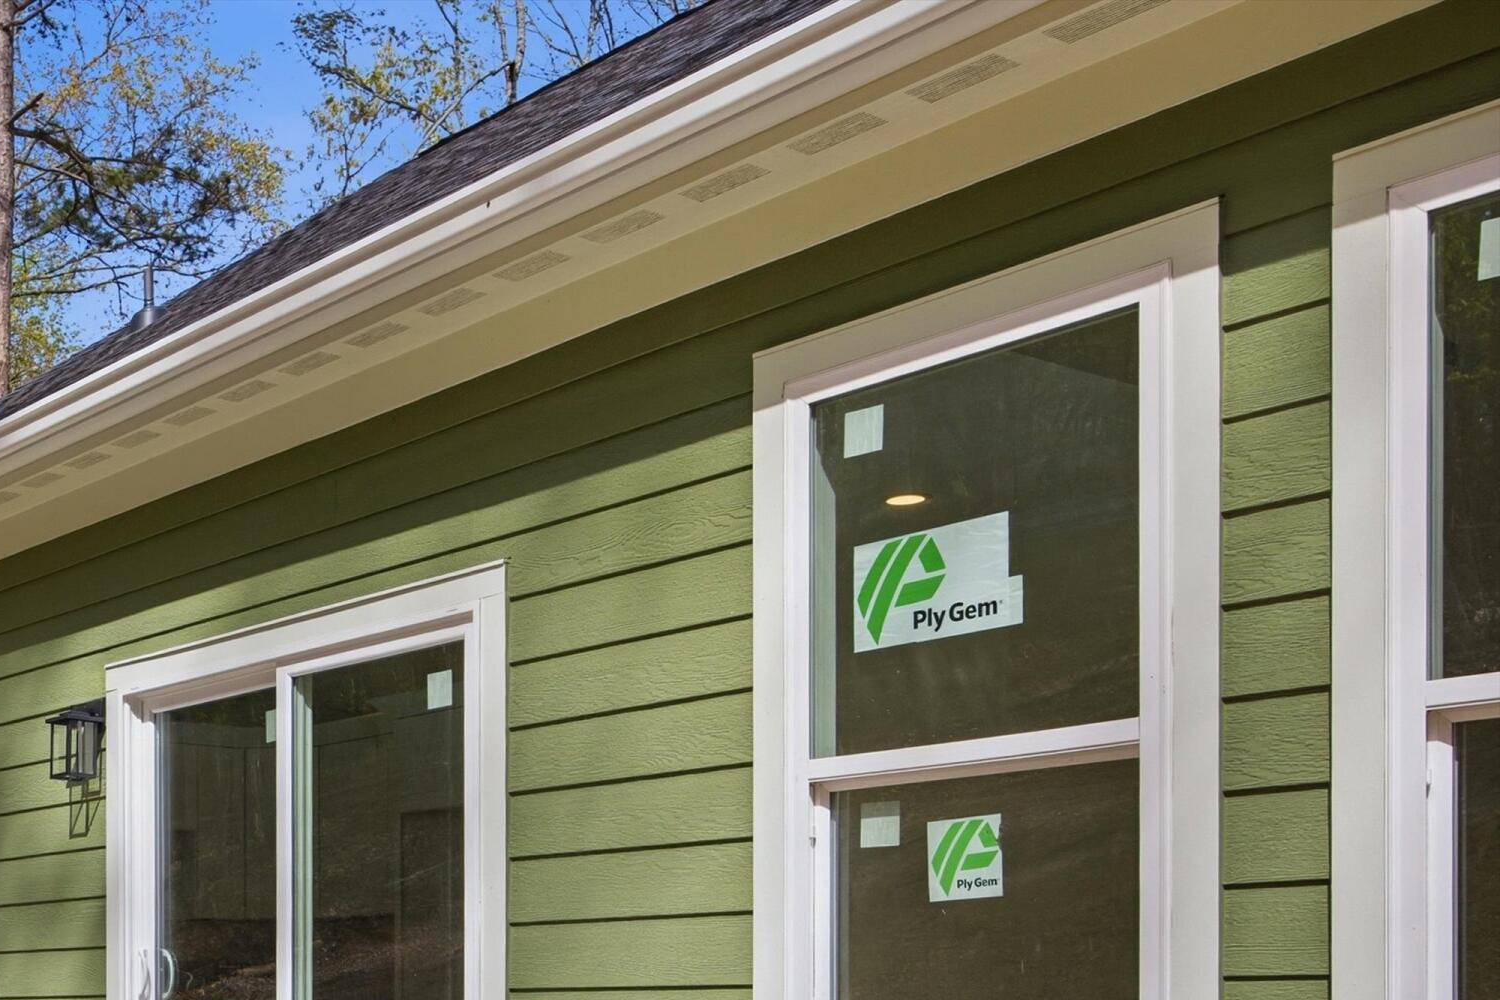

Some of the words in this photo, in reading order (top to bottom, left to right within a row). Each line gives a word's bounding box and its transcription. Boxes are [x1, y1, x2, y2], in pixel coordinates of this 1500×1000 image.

[913, 607, 946, 632] Ply
[949, 600, 998, 622] Gem
[957, 878, 973, 891] Ply
[974, 877, 998, 888] Gem
